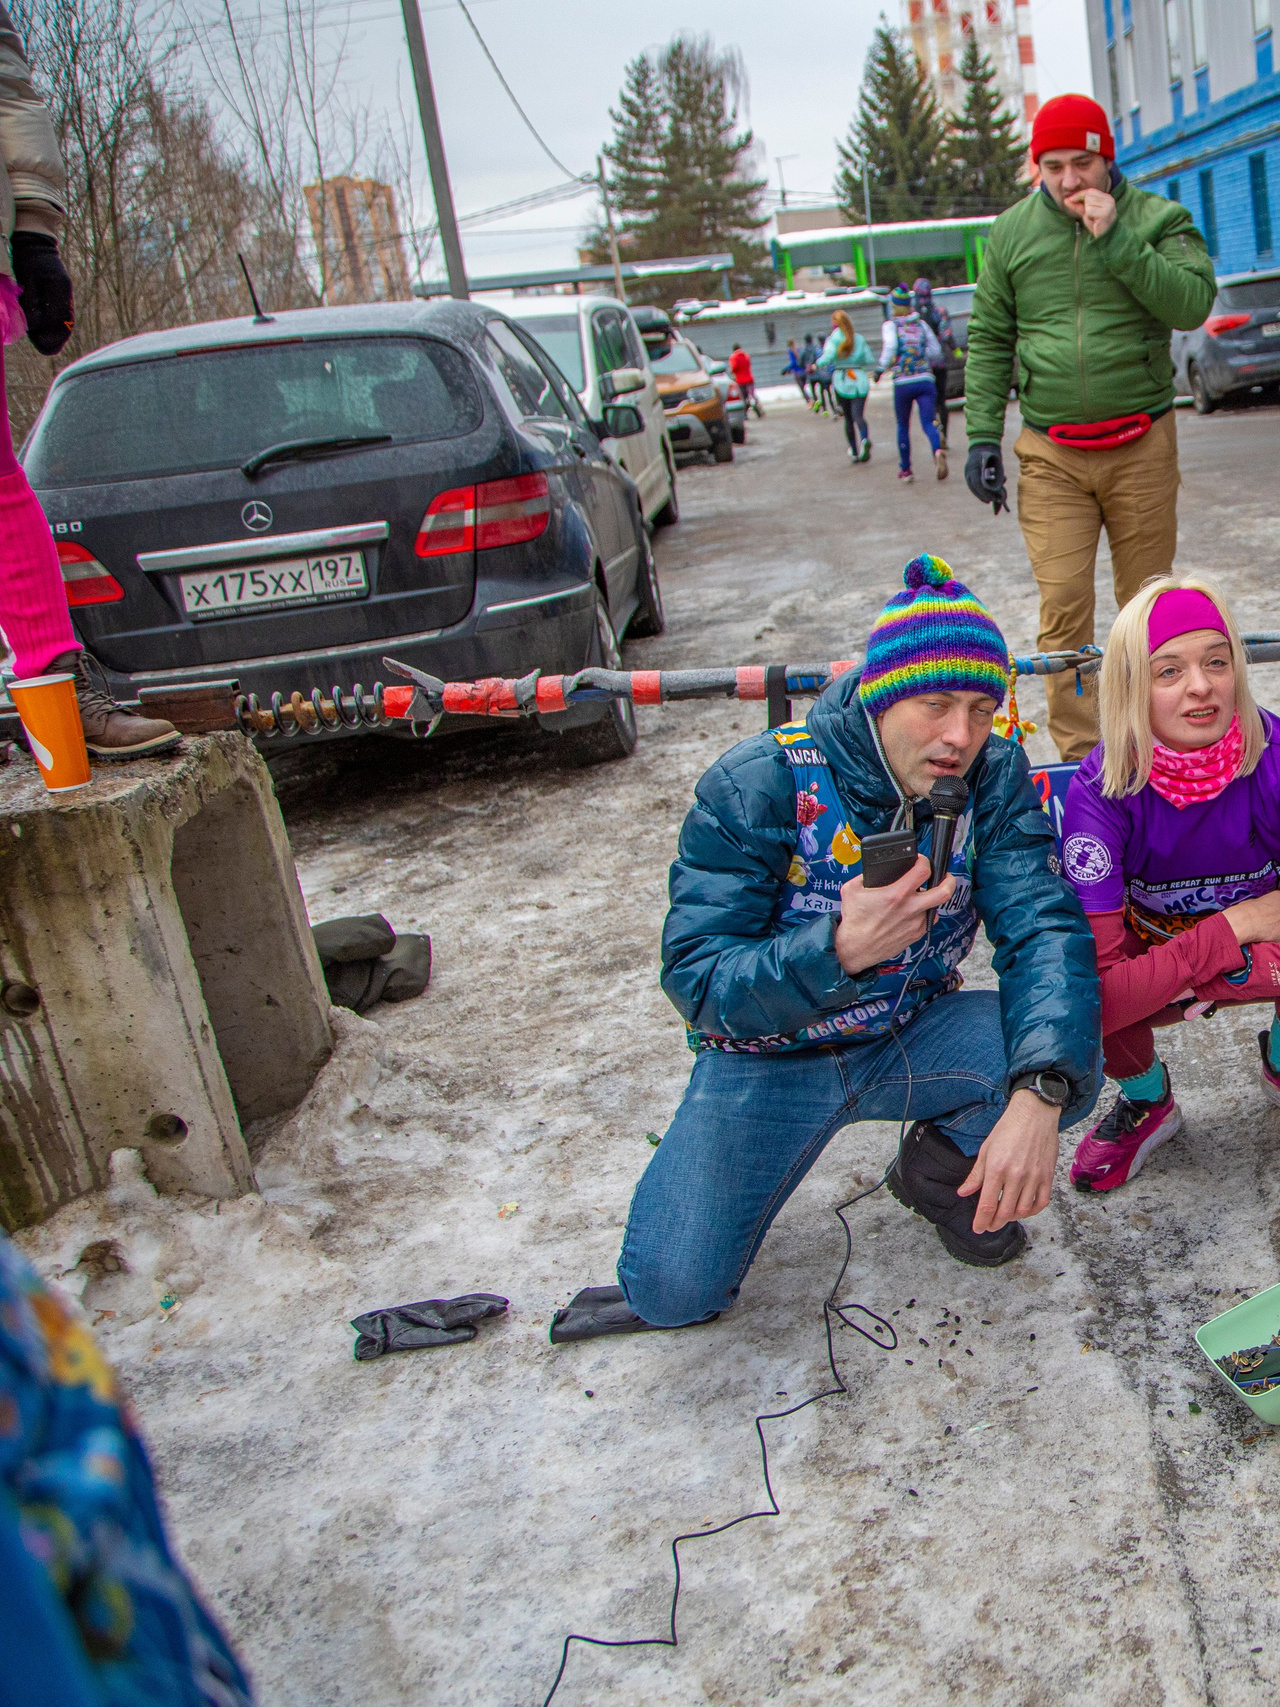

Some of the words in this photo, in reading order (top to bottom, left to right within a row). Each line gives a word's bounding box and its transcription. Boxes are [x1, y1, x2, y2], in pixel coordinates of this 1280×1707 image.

[311, 556, 353, 581] 197
[324, 579, 347, 589] RUS
[1131, 879, 1145, 889] RUN
[1146, 883, 1168, 892] BEER
[1170, 879, 1202, 889] REPEAT
[1204, 877, 1222, 886] RUN
[1224, 874, 1246, 883] BEER
[1249, 861, 1273, 879] REPEAT
[1163, 887, 1214, 914] MRC
[807, 999, 890, 1041] ЛЫСКОВО
